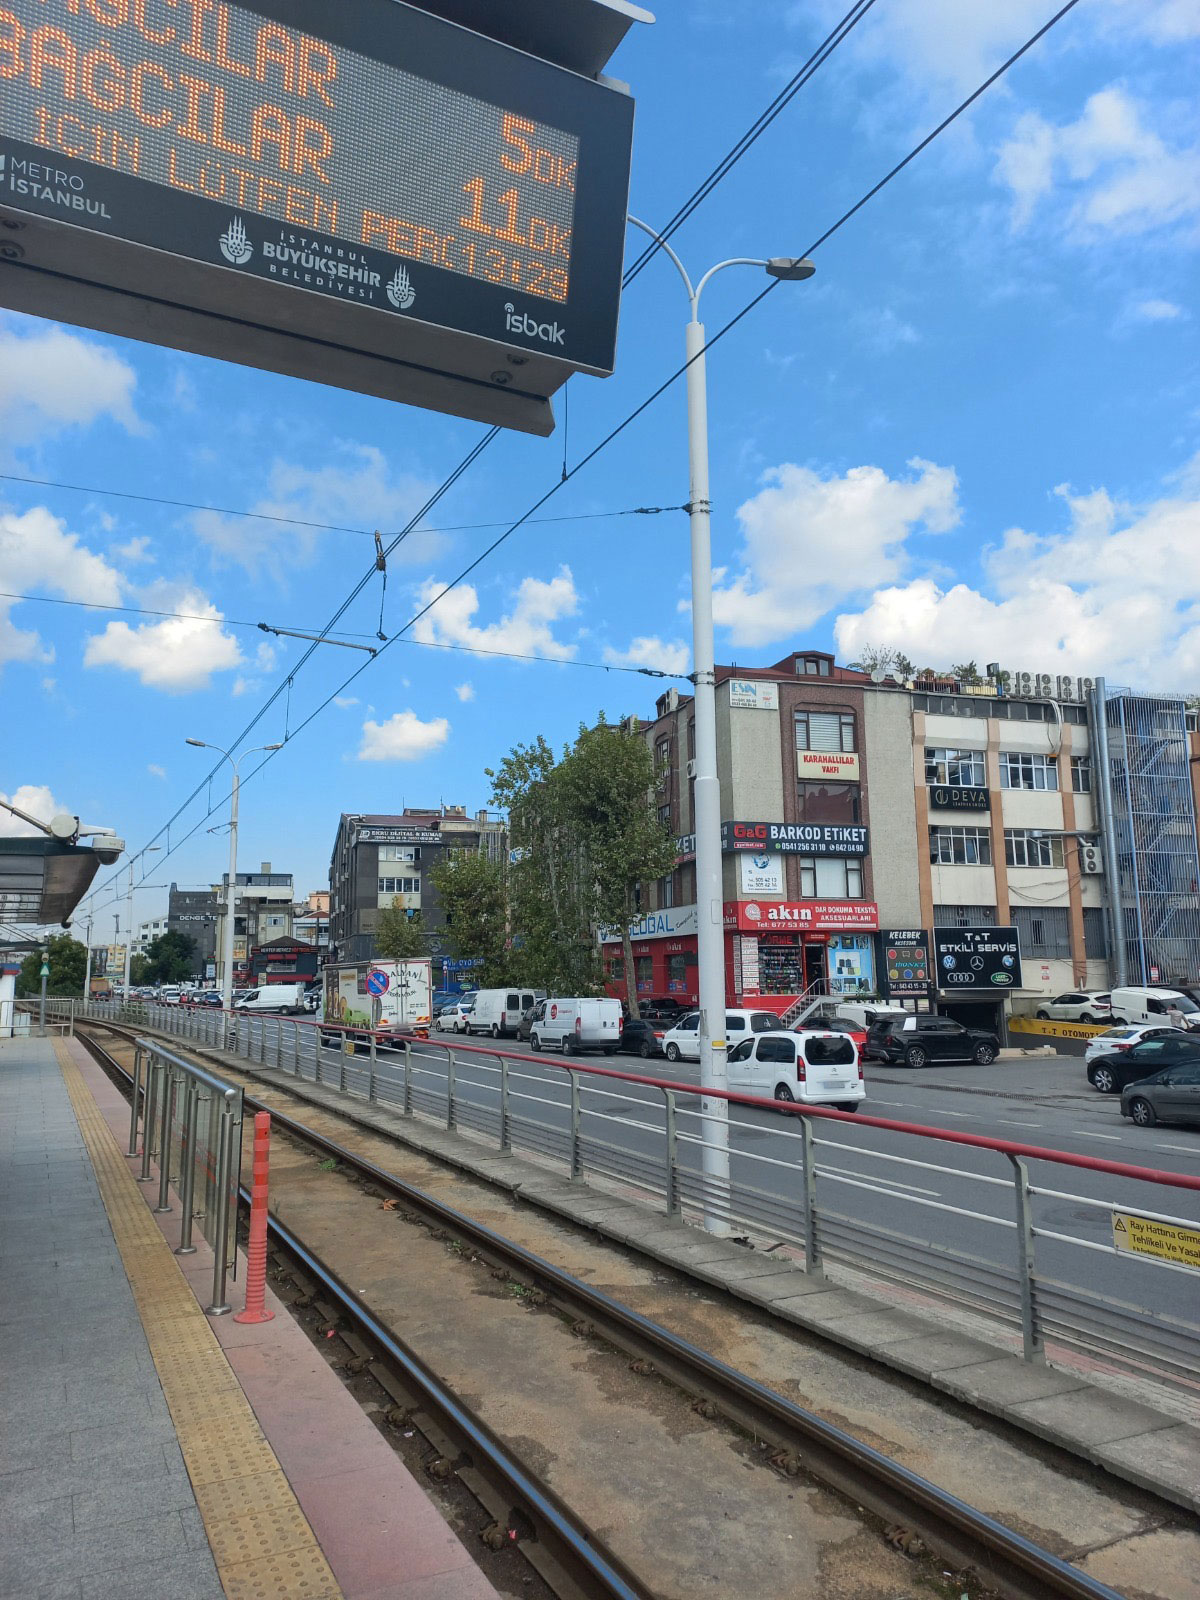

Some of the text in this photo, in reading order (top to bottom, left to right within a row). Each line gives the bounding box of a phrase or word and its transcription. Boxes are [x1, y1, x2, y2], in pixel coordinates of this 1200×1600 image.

[11, 156, 84, 191] METRO
[10, 173, 112, 219] İSTANBUL
[169, 148, 338, 233] LÜTFEN
[463, 243, 568, 299] 13:29
[280, 230, 367, 264] İSTANBUL
[263, 241, 381, 288] BÜYÜKŞEHİR
[270, 264, 373, 300] BELEDİYESİ
[803, 754, 855, 765] KARAHALLILAR
[822, 765, 839, 774] VAKFI
[952, 790, 986, 802] DEVA
[770, 825, 821, 840] BARKOD
[782, 842, 797, 850] 0541
[768, 904, 812, 920] akın
[854, 905, 877, 914] TEKSTİL
[889, 931, 921, 939] KELEBEK
[940, 941, 1017, 952] ETKİLİ SERVİS
[1130, 1220, 1145, 1233] Ray
[1146, 1224, 1176, 1238] Hattına
[1131, 1233, 1200, 1259] Tehlikeli Ve Yasa
